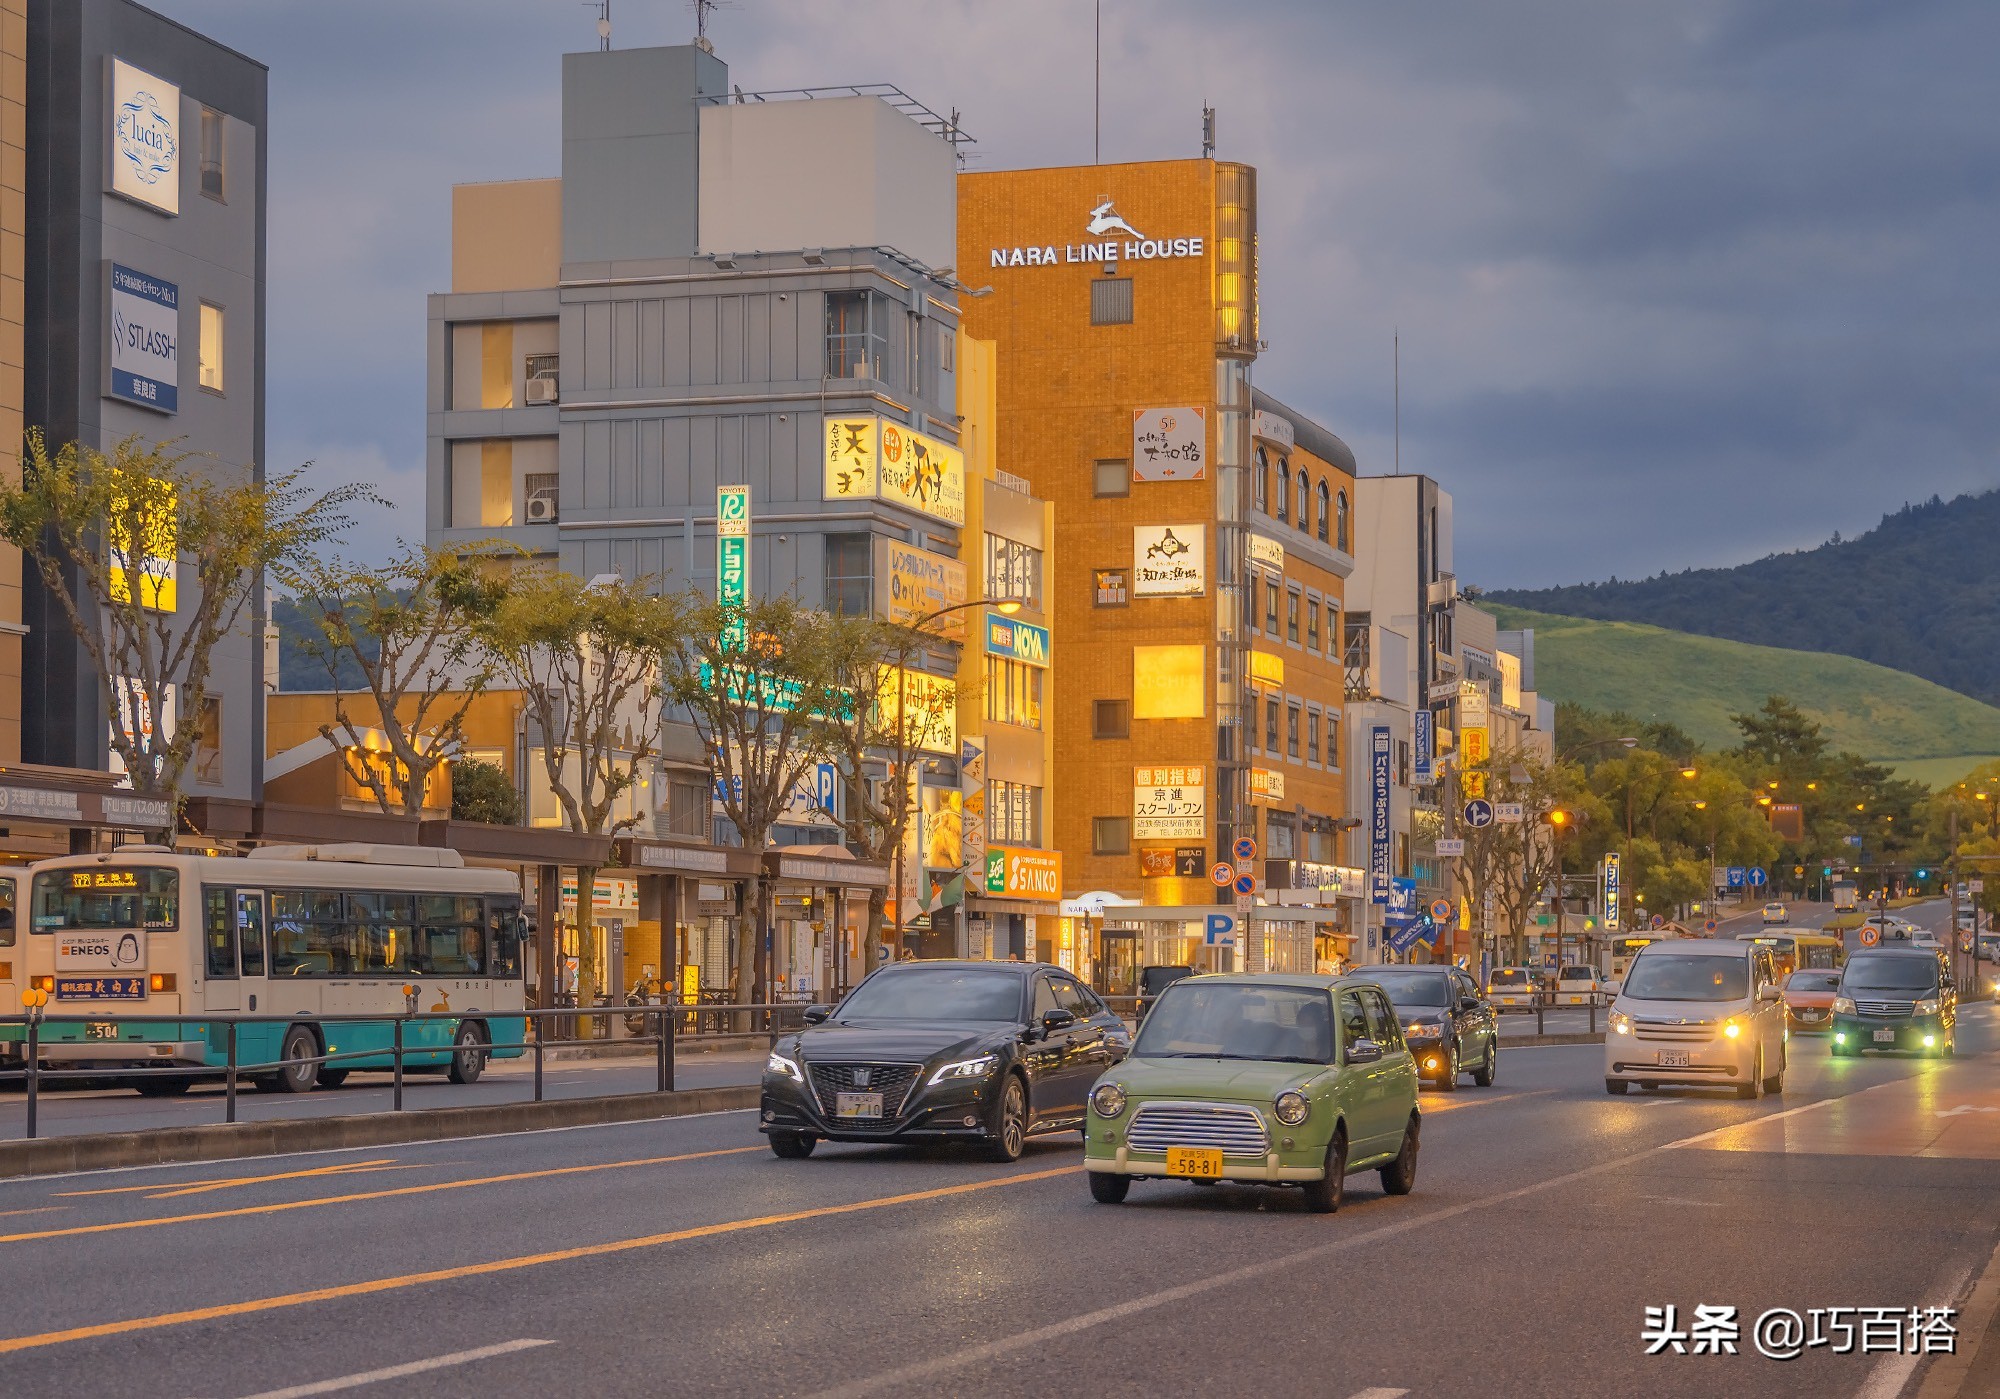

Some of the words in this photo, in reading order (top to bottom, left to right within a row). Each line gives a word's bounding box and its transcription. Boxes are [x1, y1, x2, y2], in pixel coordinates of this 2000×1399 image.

[131, 113, 163, 151] lucia
[991, 246, 1058, 268] NARA
[1066, 242, 1118, 263] LINE
[1124, 238, 1204, 260] HOUSE
[128, 322, 176, 361] STLASSH
[133, 378, 157, 401] 奈良店
[1161, 417, 1175, 429] 5F
[892, 549, 945, 584] レンタルスペース
[1013, 624, 1043, 661] NOVA
[1136, 768, 1202, 786] 個別指導
[821, 771, 832, 809] P
[1154, 788, 1184, 801] 京進
[132, 800, 168, 815] バスのりば
[1137, 803, 1202, 815] スクール・ワン
[1137, 819, 1202, 828] 近鉄奈良駅前教室
[1146, 850, 1173, 869] すき家
[1019, 867, 1057, 893] SANKO
[1206, 914, 1234, 945] P
[70, 945, 110, 956] ENEOS
[1664, 1056, 1688, 1065] 25-15
[1179, 1159, 1217, 1175] 58-81
